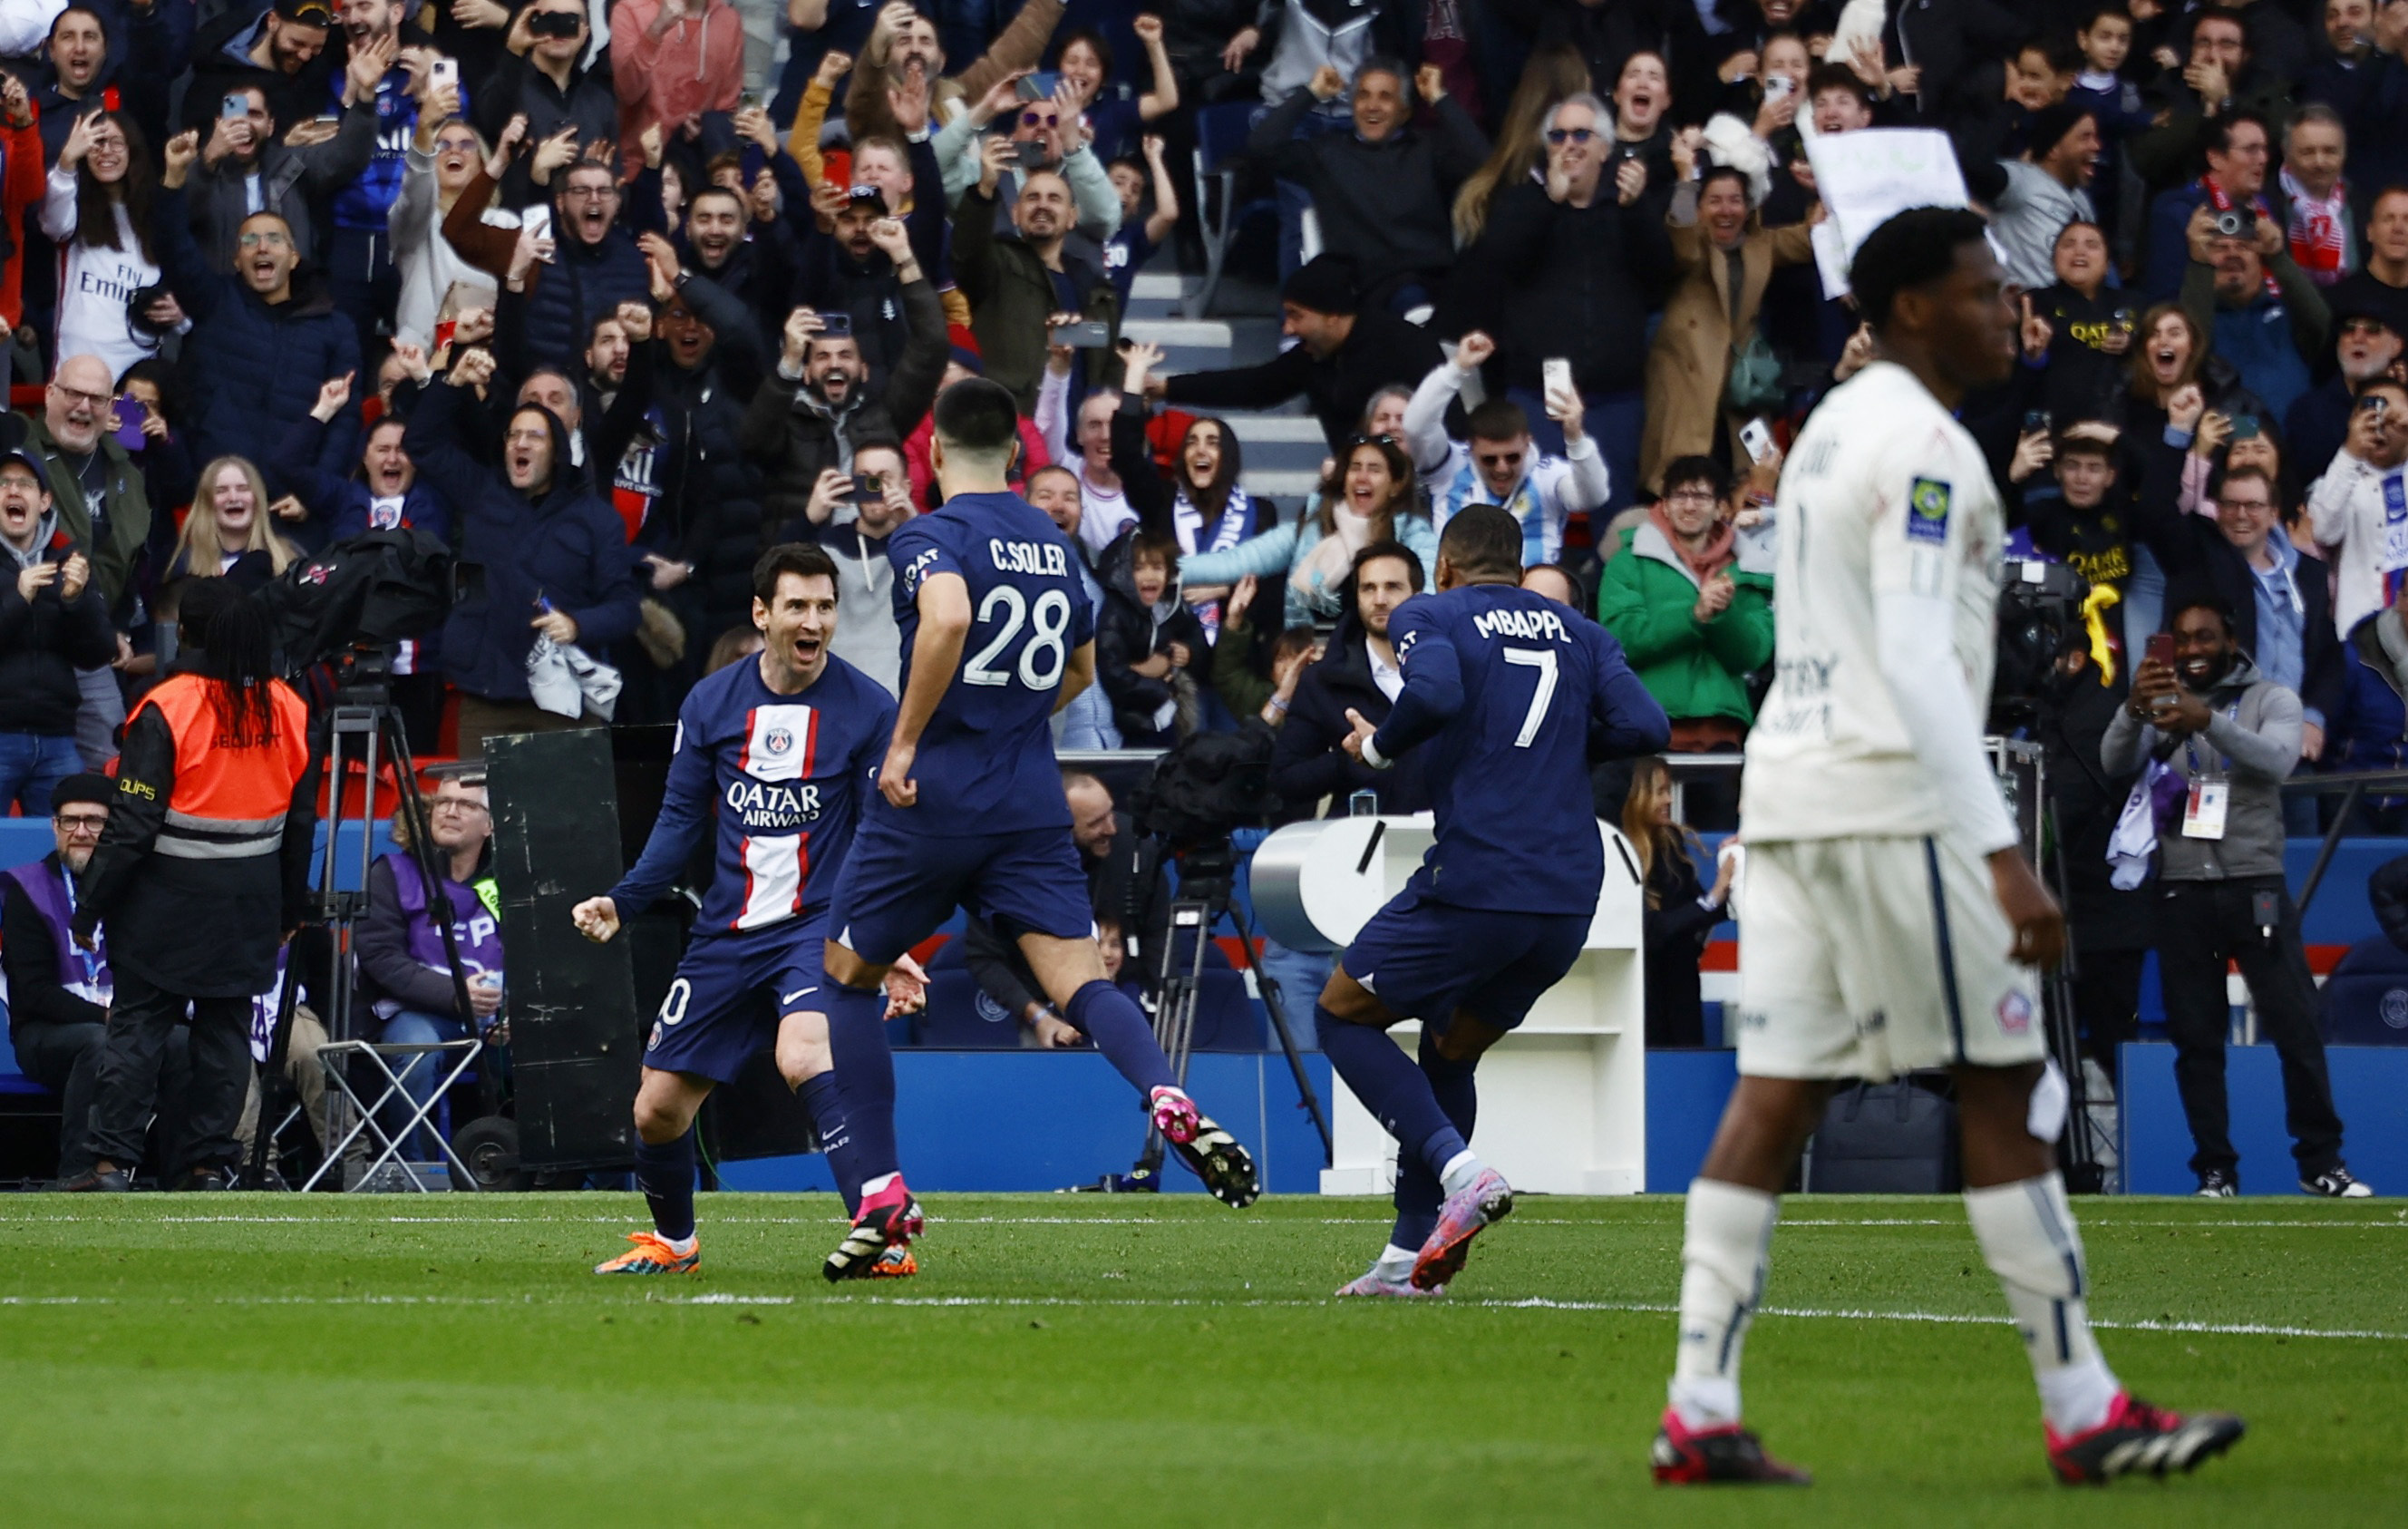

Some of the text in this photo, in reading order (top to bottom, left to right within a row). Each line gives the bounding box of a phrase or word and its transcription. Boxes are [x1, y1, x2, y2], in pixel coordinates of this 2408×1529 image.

[81, 270, 128, 304] Emi
[118, 263, 142, 287] Fly
[989, 538, 1068, 578] C.SOLER
[963, 585, 1071, 691] 28
[1503, 647, 1559, 748] 7
[726, 781, 821, 813] QATAR
[743, 809, 820, 827] AIRWAYS
